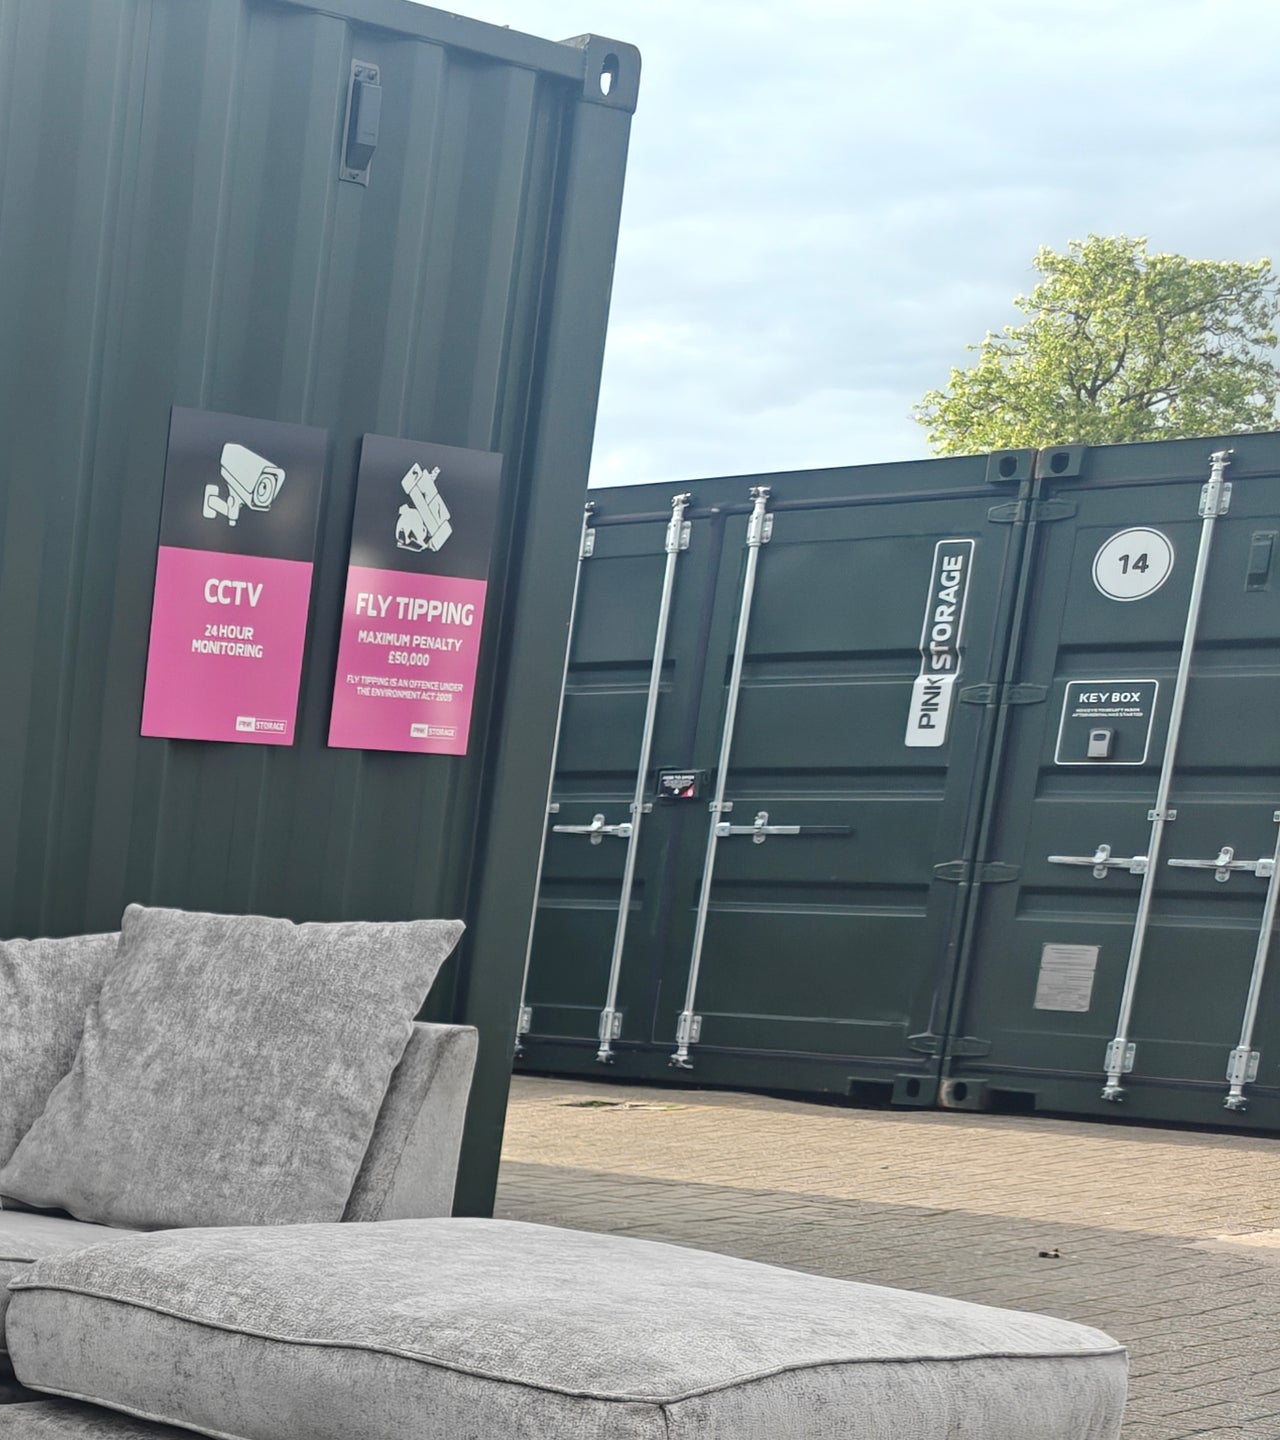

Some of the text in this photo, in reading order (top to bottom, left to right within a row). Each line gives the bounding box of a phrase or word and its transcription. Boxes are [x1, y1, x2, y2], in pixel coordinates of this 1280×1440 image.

[1118, 553, 1149, 575] 14
[204, 578, 263, 607] CCTV
[355, 592, 475, 626] FLY TIPPING
[204, 624, 254, 640] 24 HOUR
[358, 630, 463, 652] MAXIMUM PENALTY
[917, 555, 963, 730] PINK STORAGE
[191, 639, 264, 658] MONITORING
[388, 650, 430, 667] £50,000
[1079, 692, 1141, 703] KEY BOX
